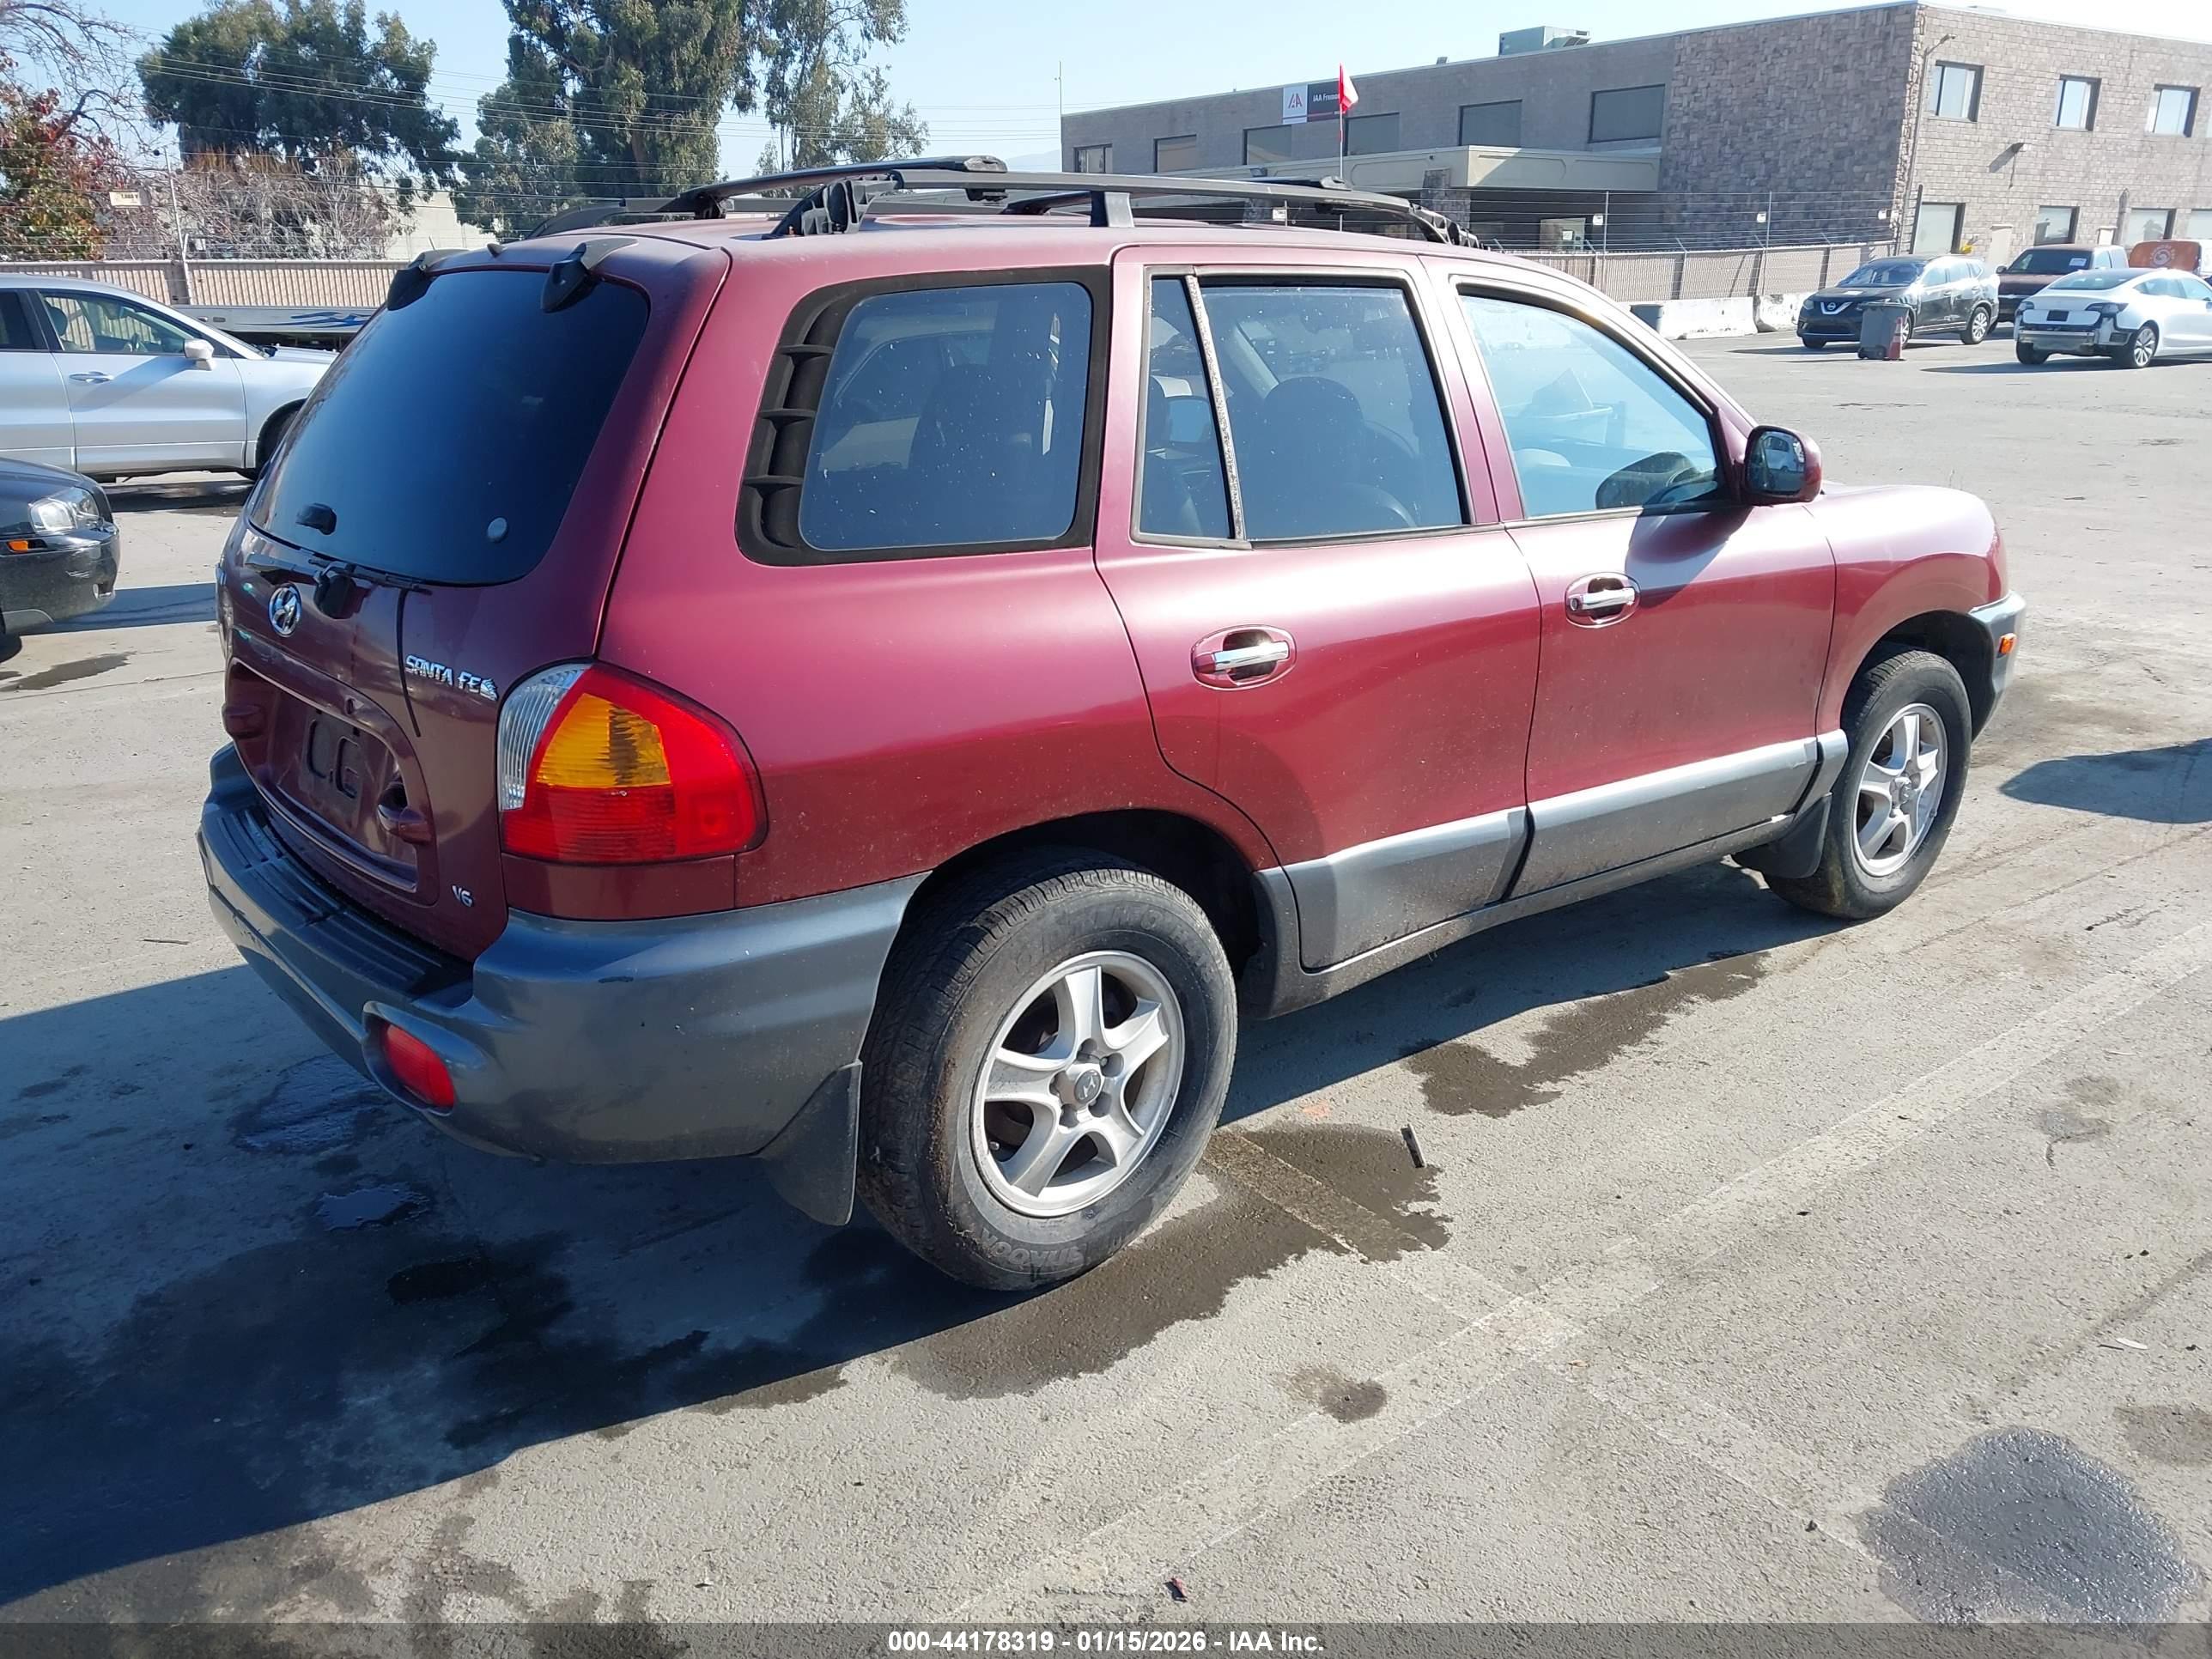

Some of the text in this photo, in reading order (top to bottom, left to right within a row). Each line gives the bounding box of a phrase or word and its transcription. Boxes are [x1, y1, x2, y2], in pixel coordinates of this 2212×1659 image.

[405, 654, 481, 693] SANTA FE
[452, 884, 473, 907] V6
